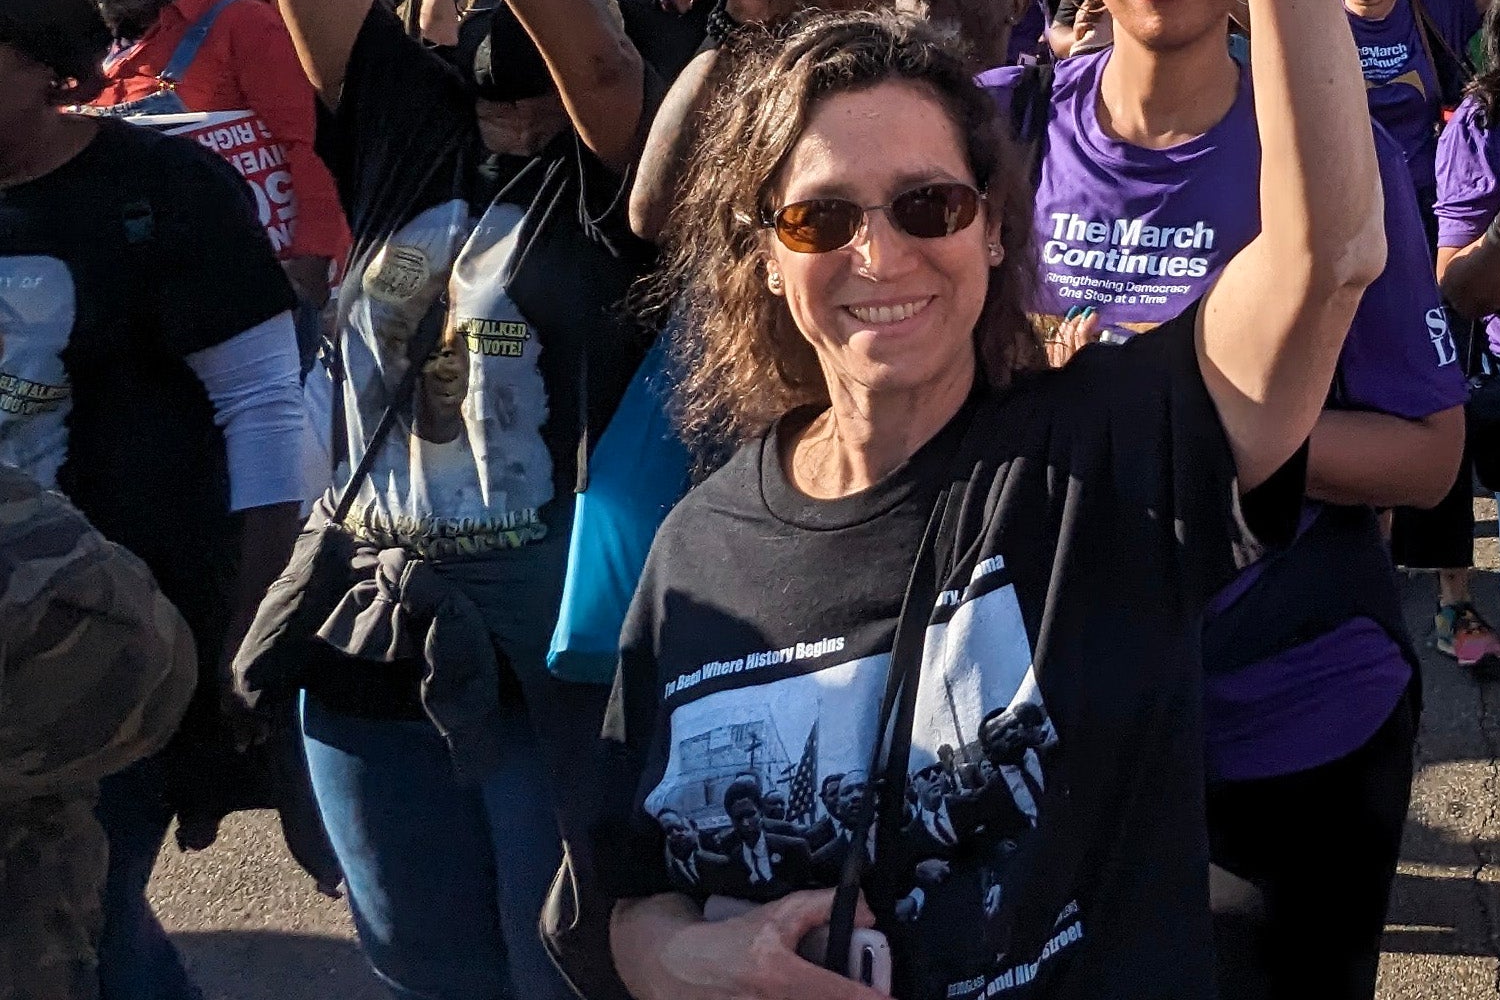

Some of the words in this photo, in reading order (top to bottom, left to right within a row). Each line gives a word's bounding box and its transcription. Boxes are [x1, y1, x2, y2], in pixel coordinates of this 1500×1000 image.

[1052, 213, 1107, 243] The
[1111, 219, 1214, 249] March
[1044, 240, 1208, 277] Continues
[1045, 272, 1124, 292] Strengthening
[1126, 281, 1191, 294] Democracy
[1059, 287, 1082, 298] One
[1115, 294, 1127, 303] at
[1128, 296, 1136, 304] a
[1138, 295, 1167, 304] Time
[483, 340, 523, 357] VOTE!
[701, 658, 743, 681] Where
[745, 646, 795, 670] History
[795, 636, 845, 659] Begins
